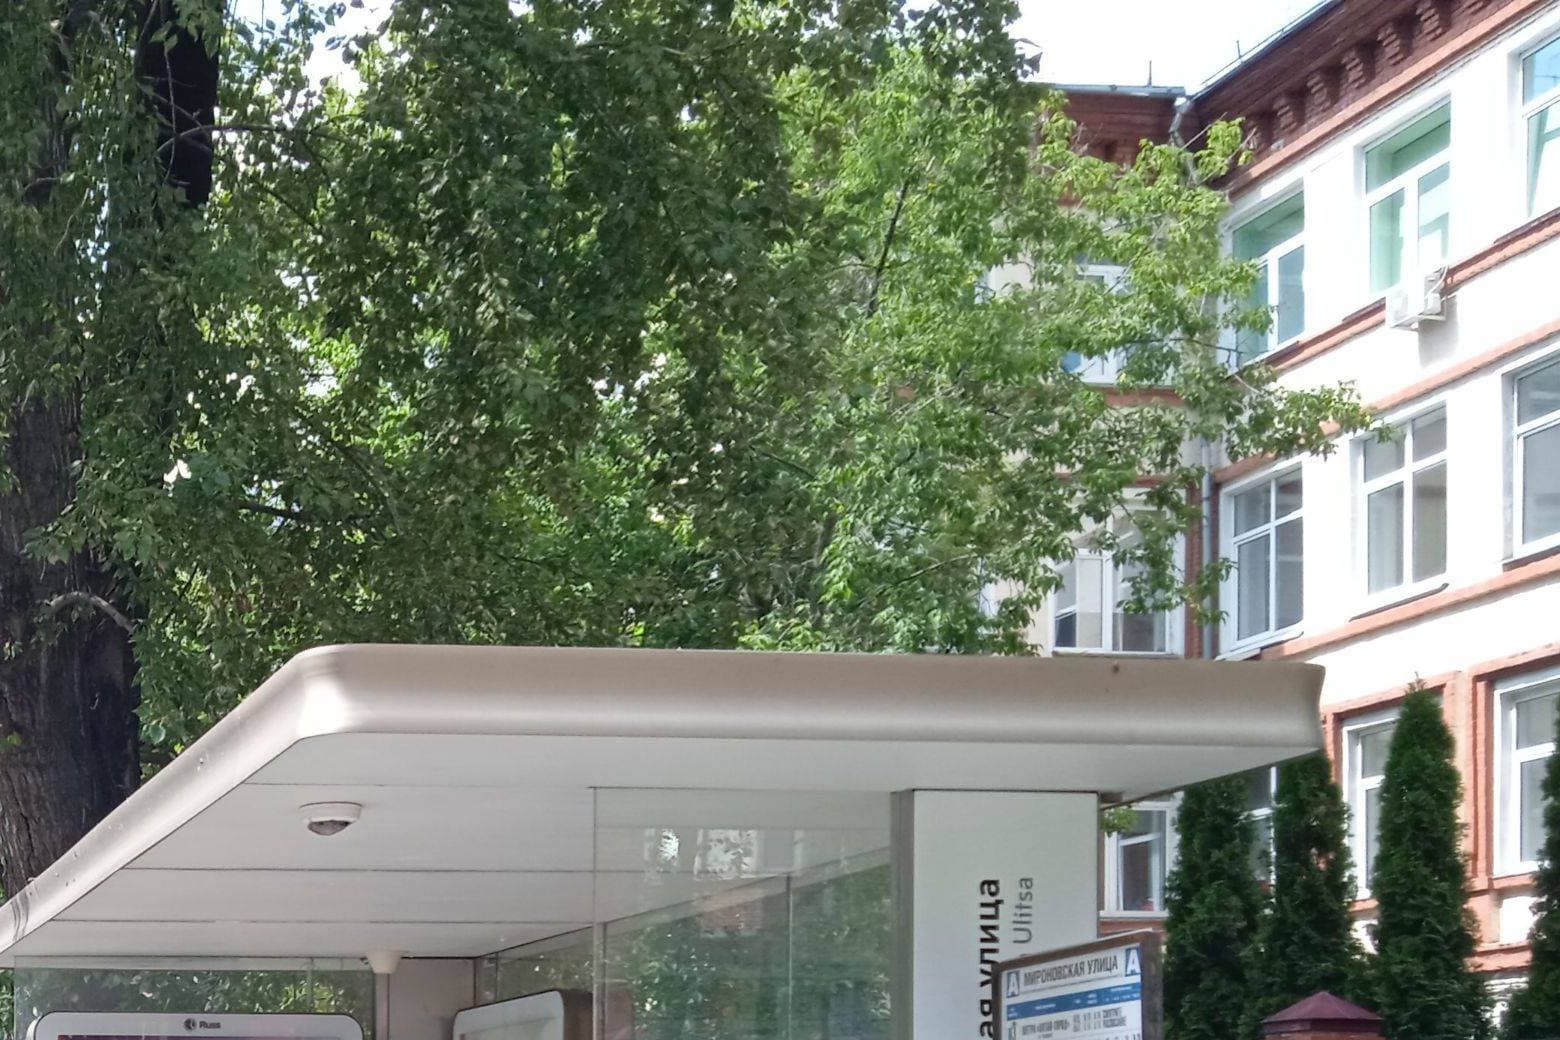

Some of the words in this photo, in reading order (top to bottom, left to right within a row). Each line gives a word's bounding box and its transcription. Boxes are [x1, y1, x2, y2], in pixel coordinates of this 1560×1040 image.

[1012, 877, 1034, 944] Ulitsa
[1024, 963, 1085, 986] МИРОНОВСКАЯ
[1088, 955, 1118, 976] УЛИЦА
[199, 1020, 221, 1029] Russ
